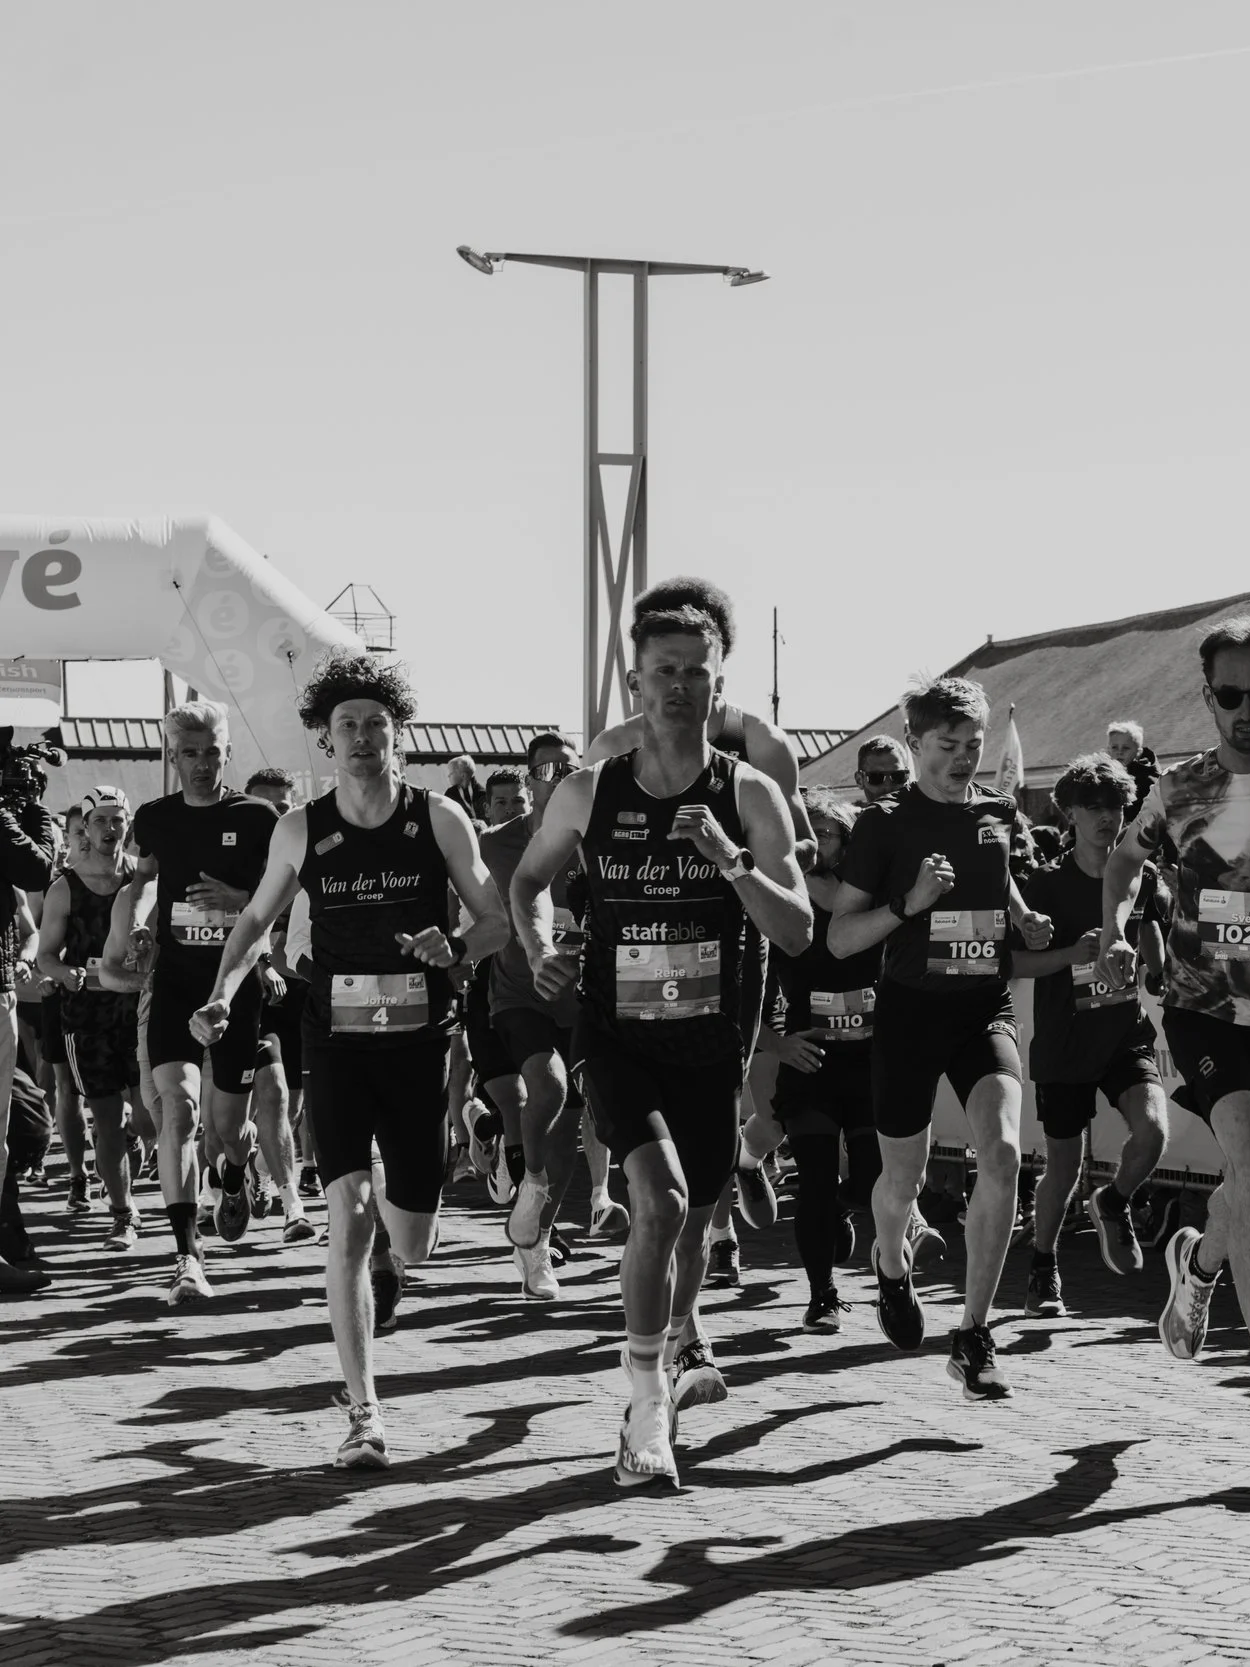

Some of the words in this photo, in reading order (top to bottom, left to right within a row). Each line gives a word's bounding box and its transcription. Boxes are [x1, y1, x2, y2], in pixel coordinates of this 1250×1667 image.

[598, 855, 630, 880] Van
[636, 855, 670, 881] der
[676, 855, 720, 880] Voor
[320, 876, 347, 894] Van
[351, 873, 377, 892] der
[381, 871, 422, 889] Voort
[356, 892, 384, 901] Groep
[643, 884, 681, 897] Groep
[185, 927, 225, 941] 1104
[621, 920, 706, 942] staffable
[949, 941, 996, 959] 1106
[654, 968, 686, 978] Rene
[662, 980, 679, 1001] 6
[363, 994, 398, 1005] Joffre
[371, 1006, 389, 1025] 4
[703, 1005, 710, 1013] 6
[827, 1014, 863, 1029] 1110
